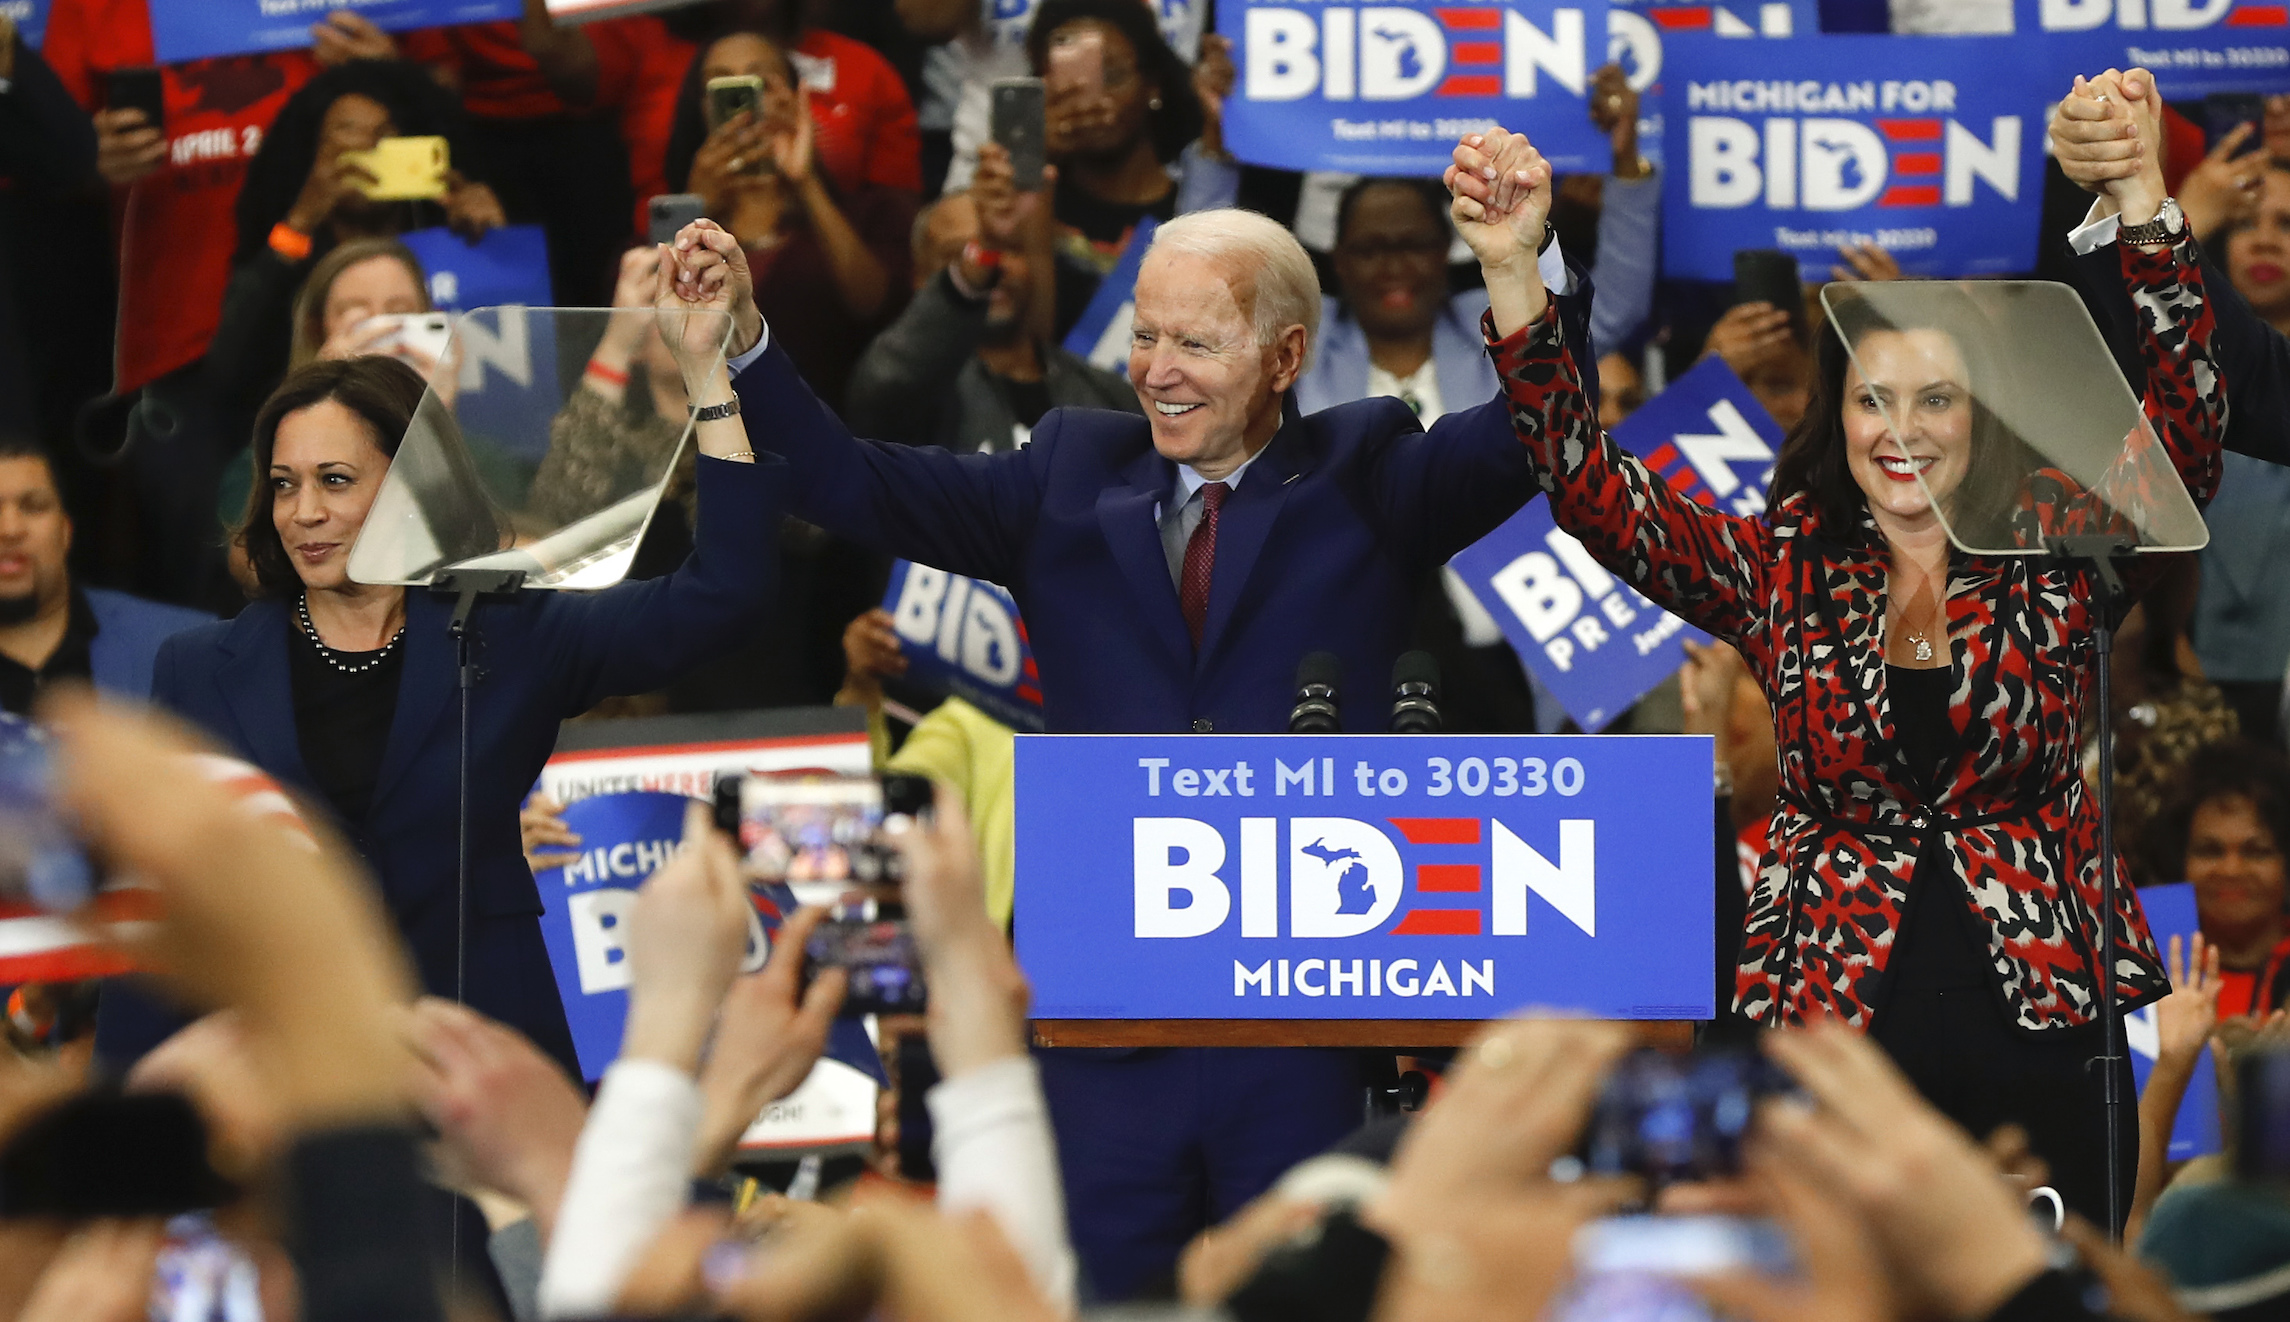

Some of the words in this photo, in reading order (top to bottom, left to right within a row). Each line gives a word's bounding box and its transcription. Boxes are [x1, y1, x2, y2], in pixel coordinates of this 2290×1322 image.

[1245, 7, 1587, 100] BIDEN
[1332, 118, 1376, 140] Text
[1687, 80, 1876, 112] MICHIGAN
[1880, 80, 1957, 112] FOR
[1688, 115, 2022, 211] BIDEN
[893, 560, 1043, 707] BID
[1138, 756, 1255, 798] Text
[1275, 756, 1335, 797] MI
[1354, 756, 1410, 798] to
[1426, 756, 1586, 798] 30330
[1132, 816, 1597, 939] BIDEN
[1233, 958, 1496, 998] MICHIGAN
